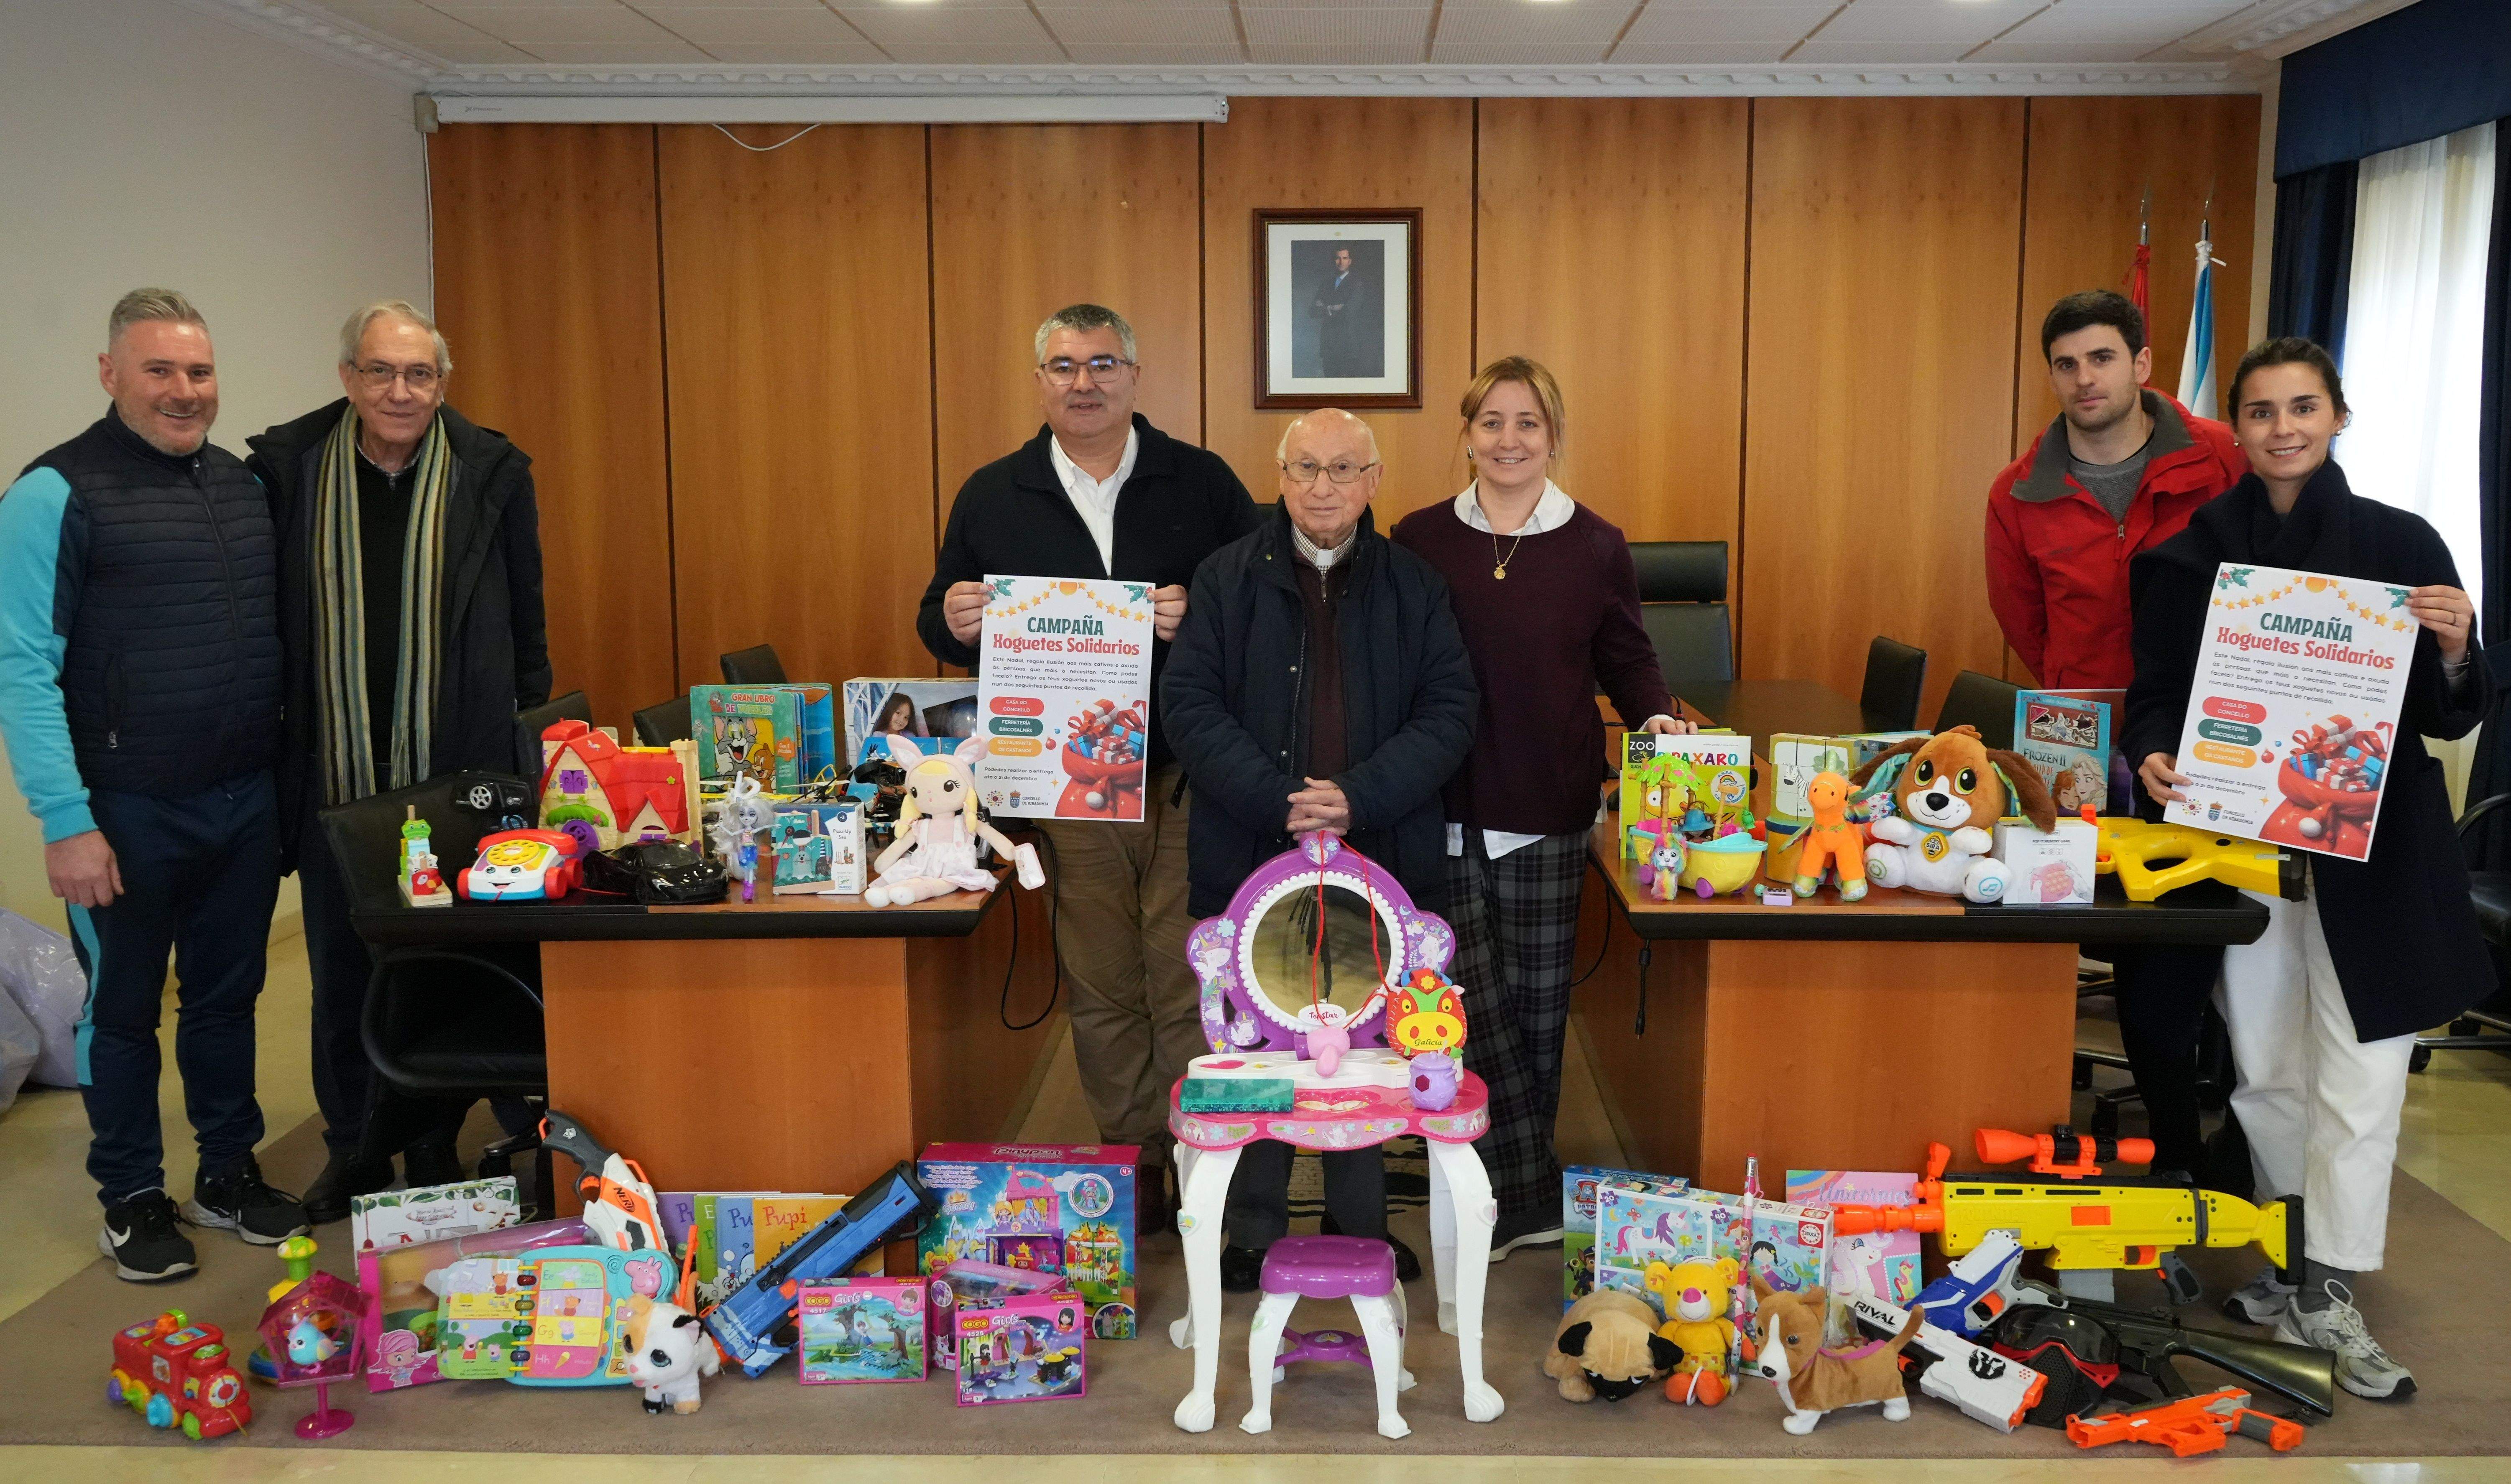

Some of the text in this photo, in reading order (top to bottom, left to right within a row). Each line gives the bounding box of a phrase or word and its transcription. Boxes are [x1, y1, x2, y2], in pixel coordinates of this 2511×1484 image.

[1027, 615, 1104, 636] CAMPAÑA
[2260, 612, 2353, 643] CAMPAÑA
[993, 633, 1139, 655] Xoguetes Solidarios
[2216, 626, 2395, 670] Xoguetes Solidarios
[732, 693, 775, 703] GRAN LIBRO
[725, 704, 736, 713] DE
[1629, 741, 1655, 750] ZOO
[2023, 748, 2066, 767] FROZEN II
[1926, 842, 1939, 851] SIRA
[763, 1206, 807, 1231] Pupi
[543, 1270, 554, 1280] Ee
[805, 1296, 831, 1306] COGO
[1853, 1300, 1896, 1325] RIVAL
[962, 1319, 989, 1330] COGO
[538, 1325, 554, 1339] Gg
